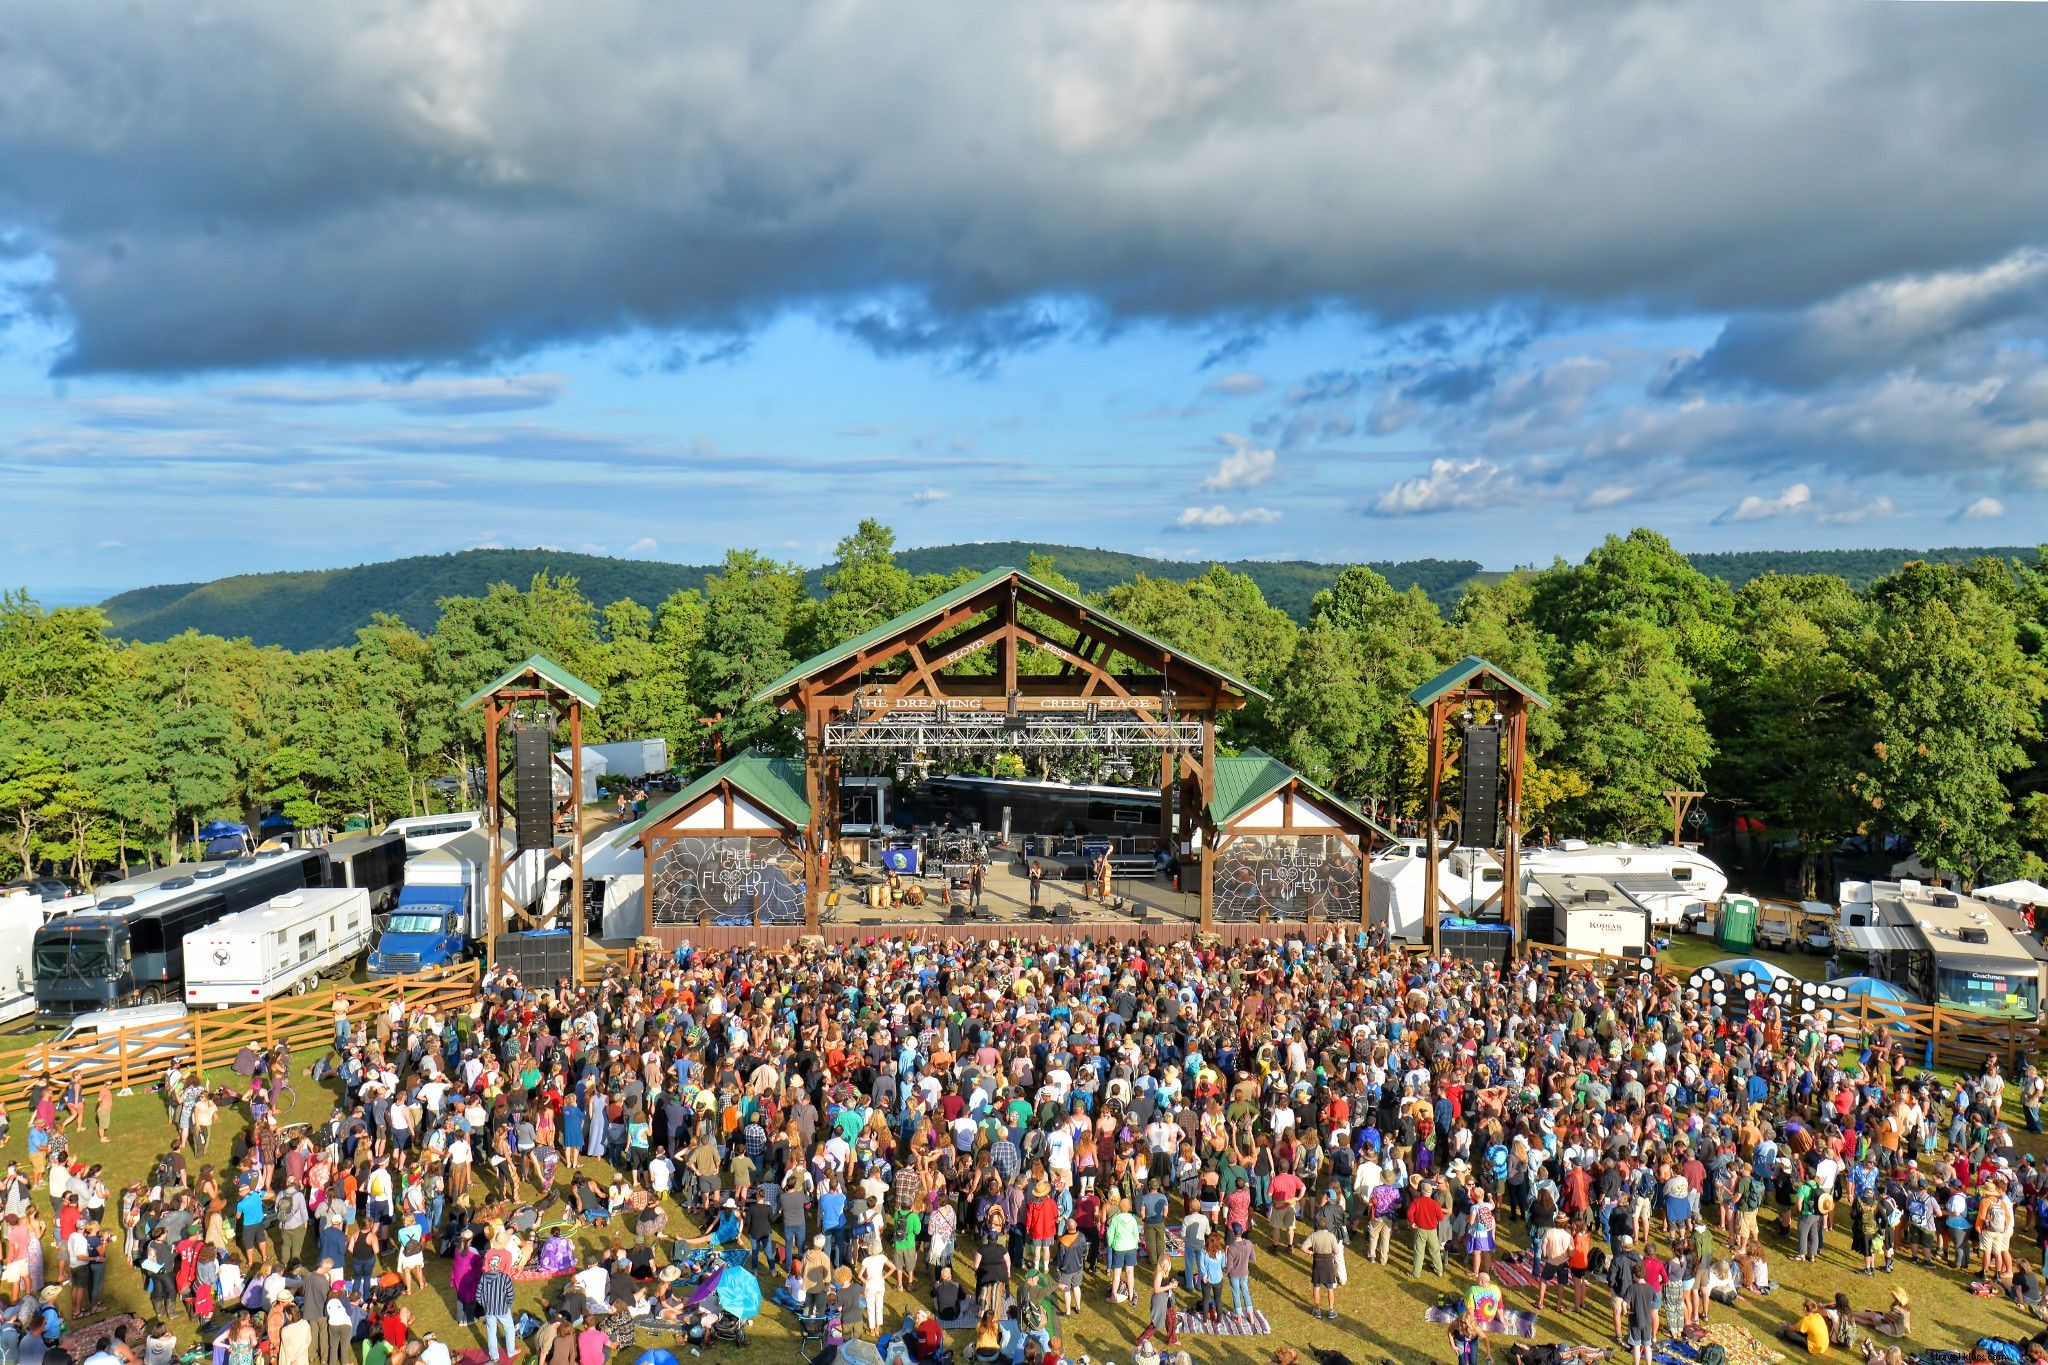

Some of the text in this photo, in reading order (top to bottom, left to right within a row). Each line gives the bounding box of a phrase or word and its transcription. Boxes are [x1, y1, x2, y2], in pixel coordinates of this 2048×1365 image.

[946, 639, 1071, 662] FLOYD FEST
[895, 698, 983, 708] DREAMING
[1040, 699, 1094, 708] CREEK
[1100, 699, 1150, 708] STAGE
[707, 851, 715, 860] A
[1265, 848, 1273, 857] A
[722, 859, 768, 870] CALLED
[1280, 857, 1324, 867] CALLED
[737, 881, 769, 899] FEST
[1294, 878, 1325, 896] FEST
[1972, 972, 2006, 981] Coachmen
